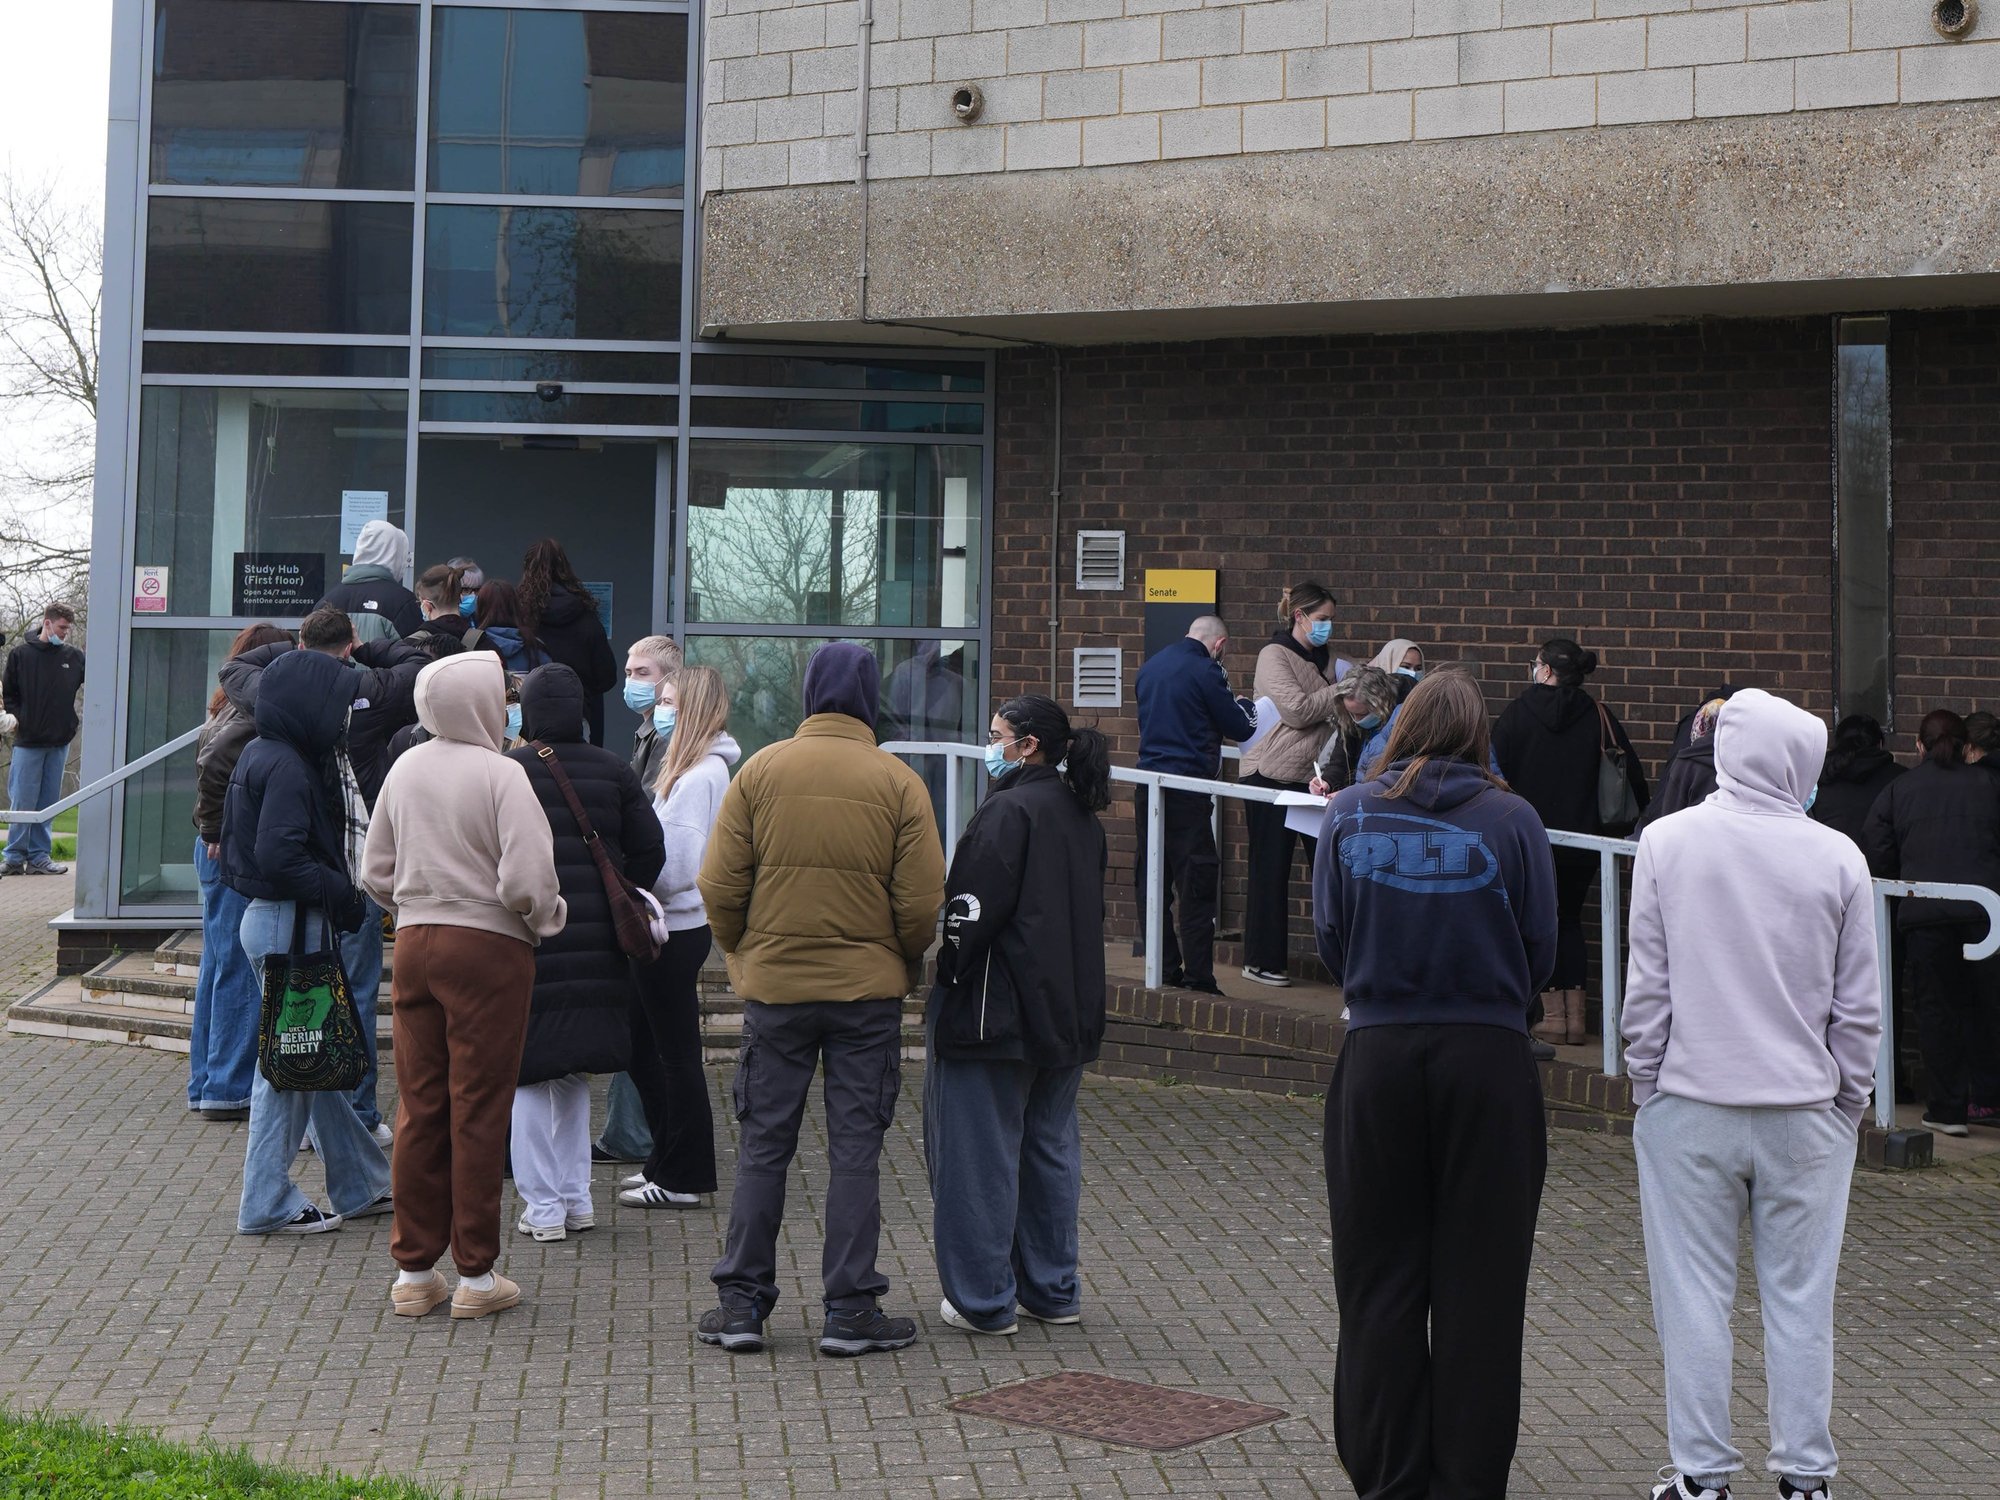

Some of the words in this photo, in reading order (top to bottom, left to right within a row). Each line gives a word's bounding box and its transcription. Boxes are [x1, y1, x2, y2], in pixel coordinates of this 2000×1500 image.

[244, 564, 275, 575] Study
[278, 564, 300, 574] Hub
[244, 575, 273, 586] (First
[275, 575, 304, 586] floor)
[1149, 587, 1178, 597] Senate
[1338, 831, 1483, 879] PLT
[280, 1042, 319, 1054] SOCIETY
